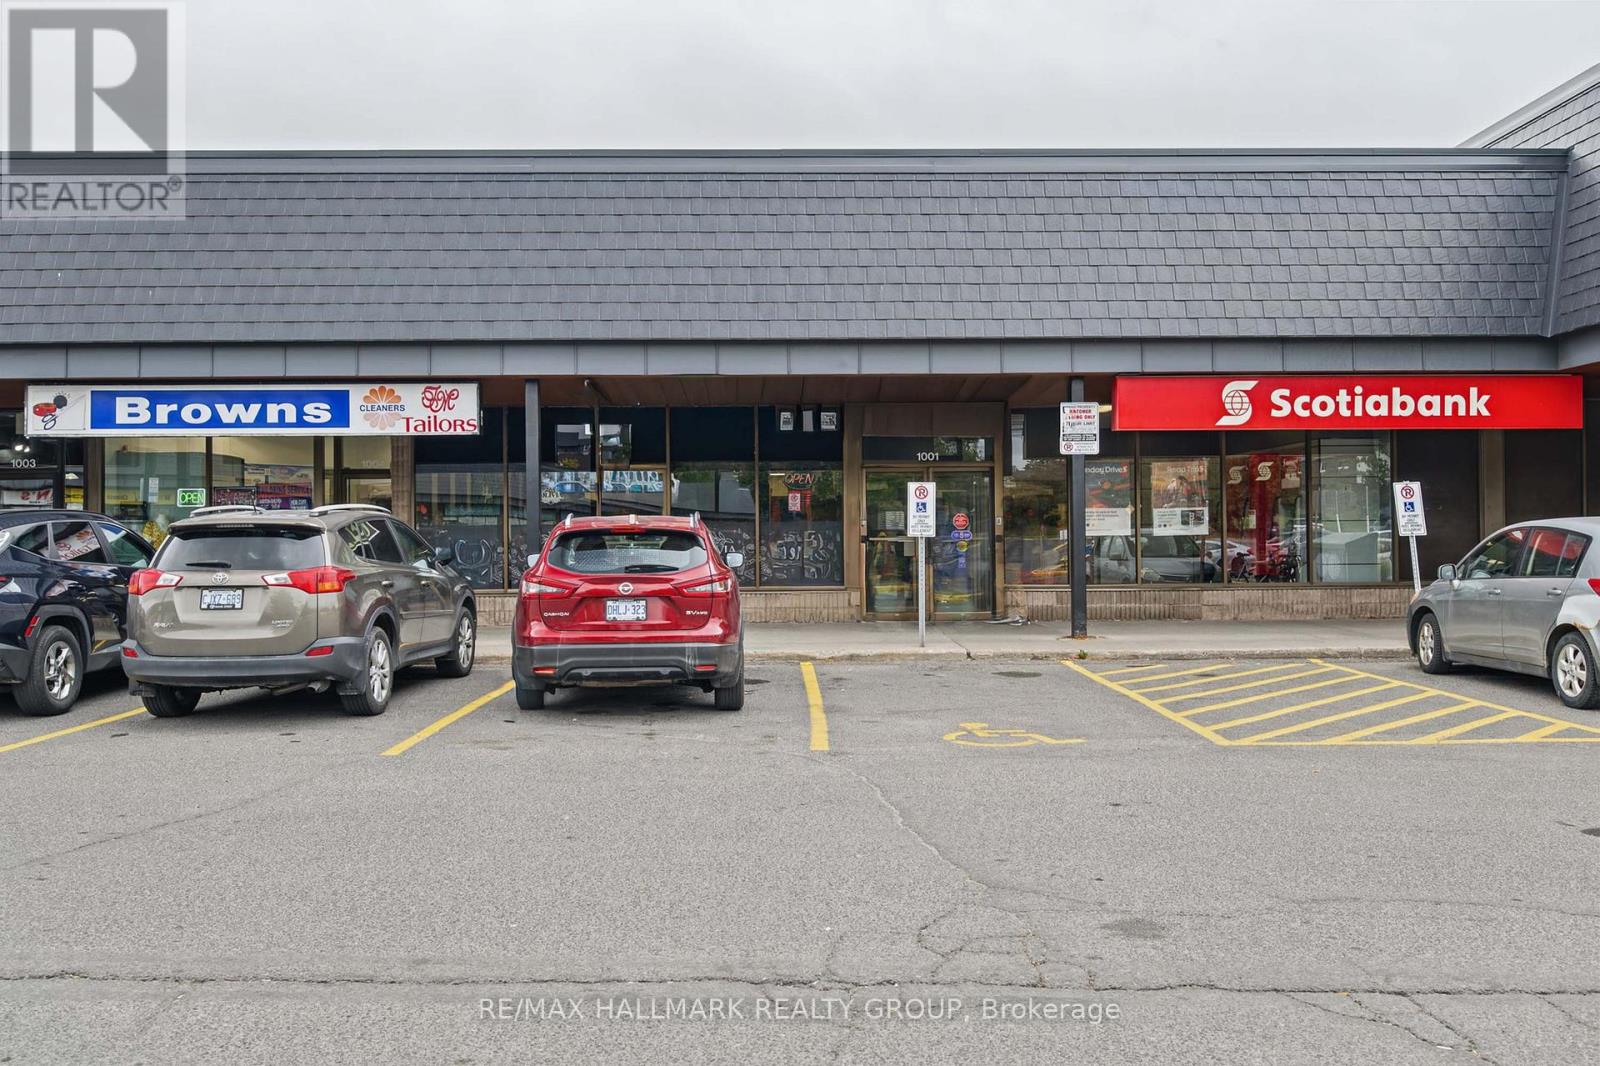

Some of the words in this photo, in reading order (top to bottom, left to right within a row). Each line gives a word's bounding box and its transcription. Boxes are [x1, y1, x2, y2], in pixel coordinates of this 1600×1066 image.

[1270, 385, 1491, 417] Scotiabank
[115, 396, 332, 425] Browns
[360, 404, 406, 412] CLEANERS
[401, 415, 477, 432] Tailors
[916, 452, 939, 461] 1001
[10, 459, 37, 468] 1003
[785, 473, 814, 485] OPEN
[180, 490, 204, 504] OPEN
